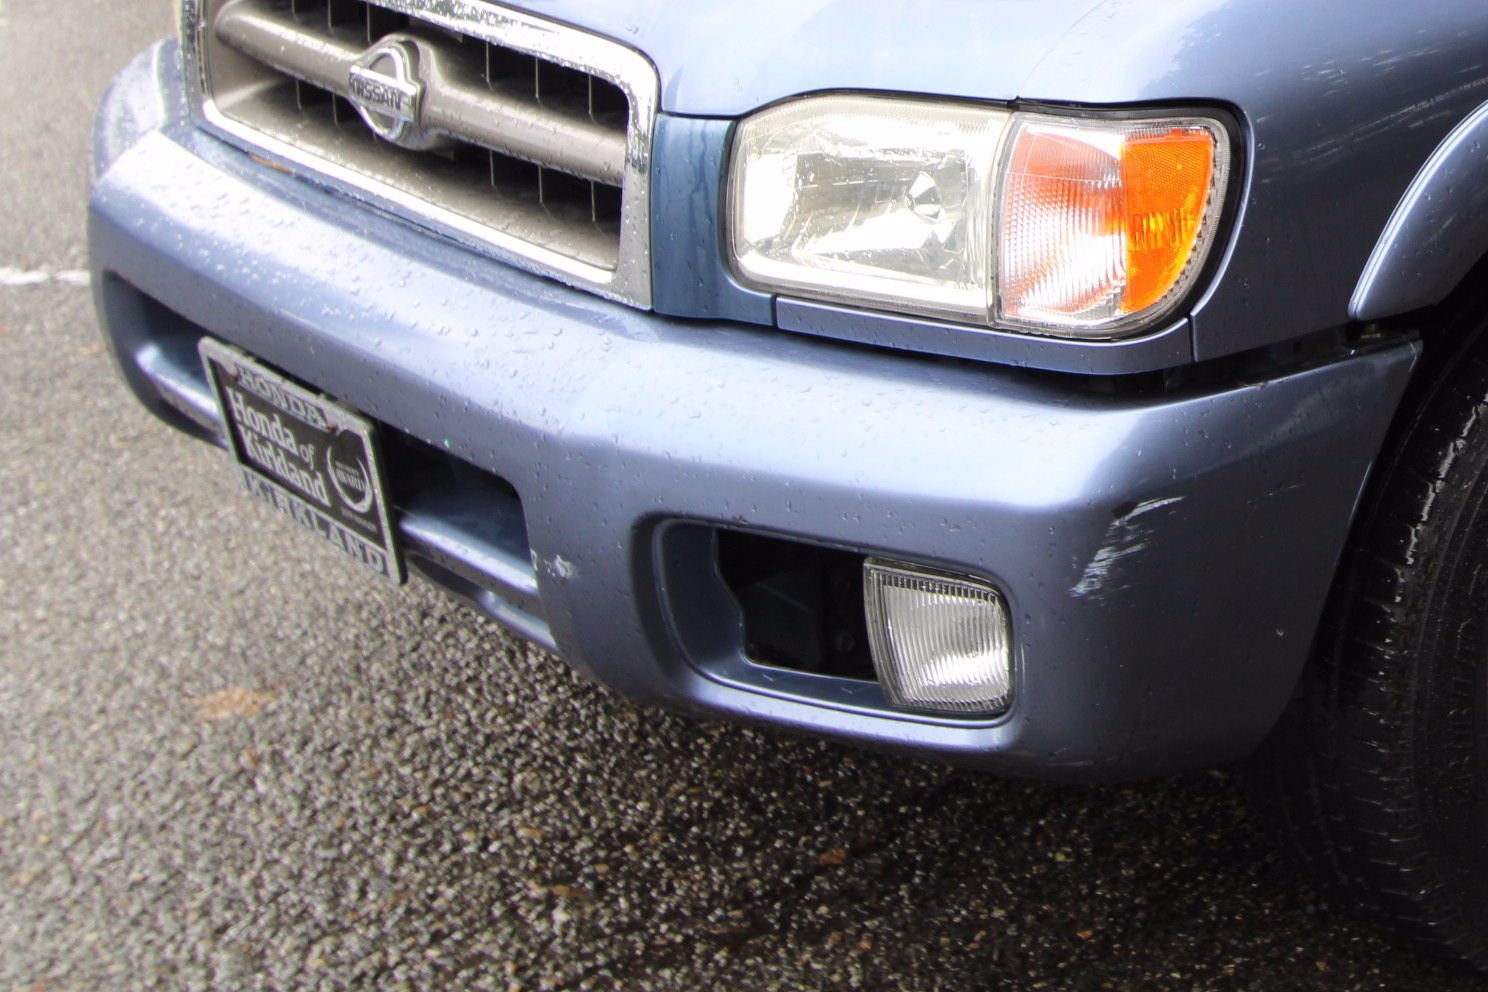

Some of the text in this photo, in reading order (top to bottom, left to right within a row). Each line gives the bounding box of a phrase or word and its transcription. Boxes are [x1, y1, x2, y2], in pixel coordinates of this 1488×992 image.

[351, 77, 402, 110] NISSAN
[226, 386, 314, 470] Honda of
[238, 365, 327, 428] HONDA
[238, 423, 331, 507] Kirkland
[247, 472, 385, 574] KIRKLAND
